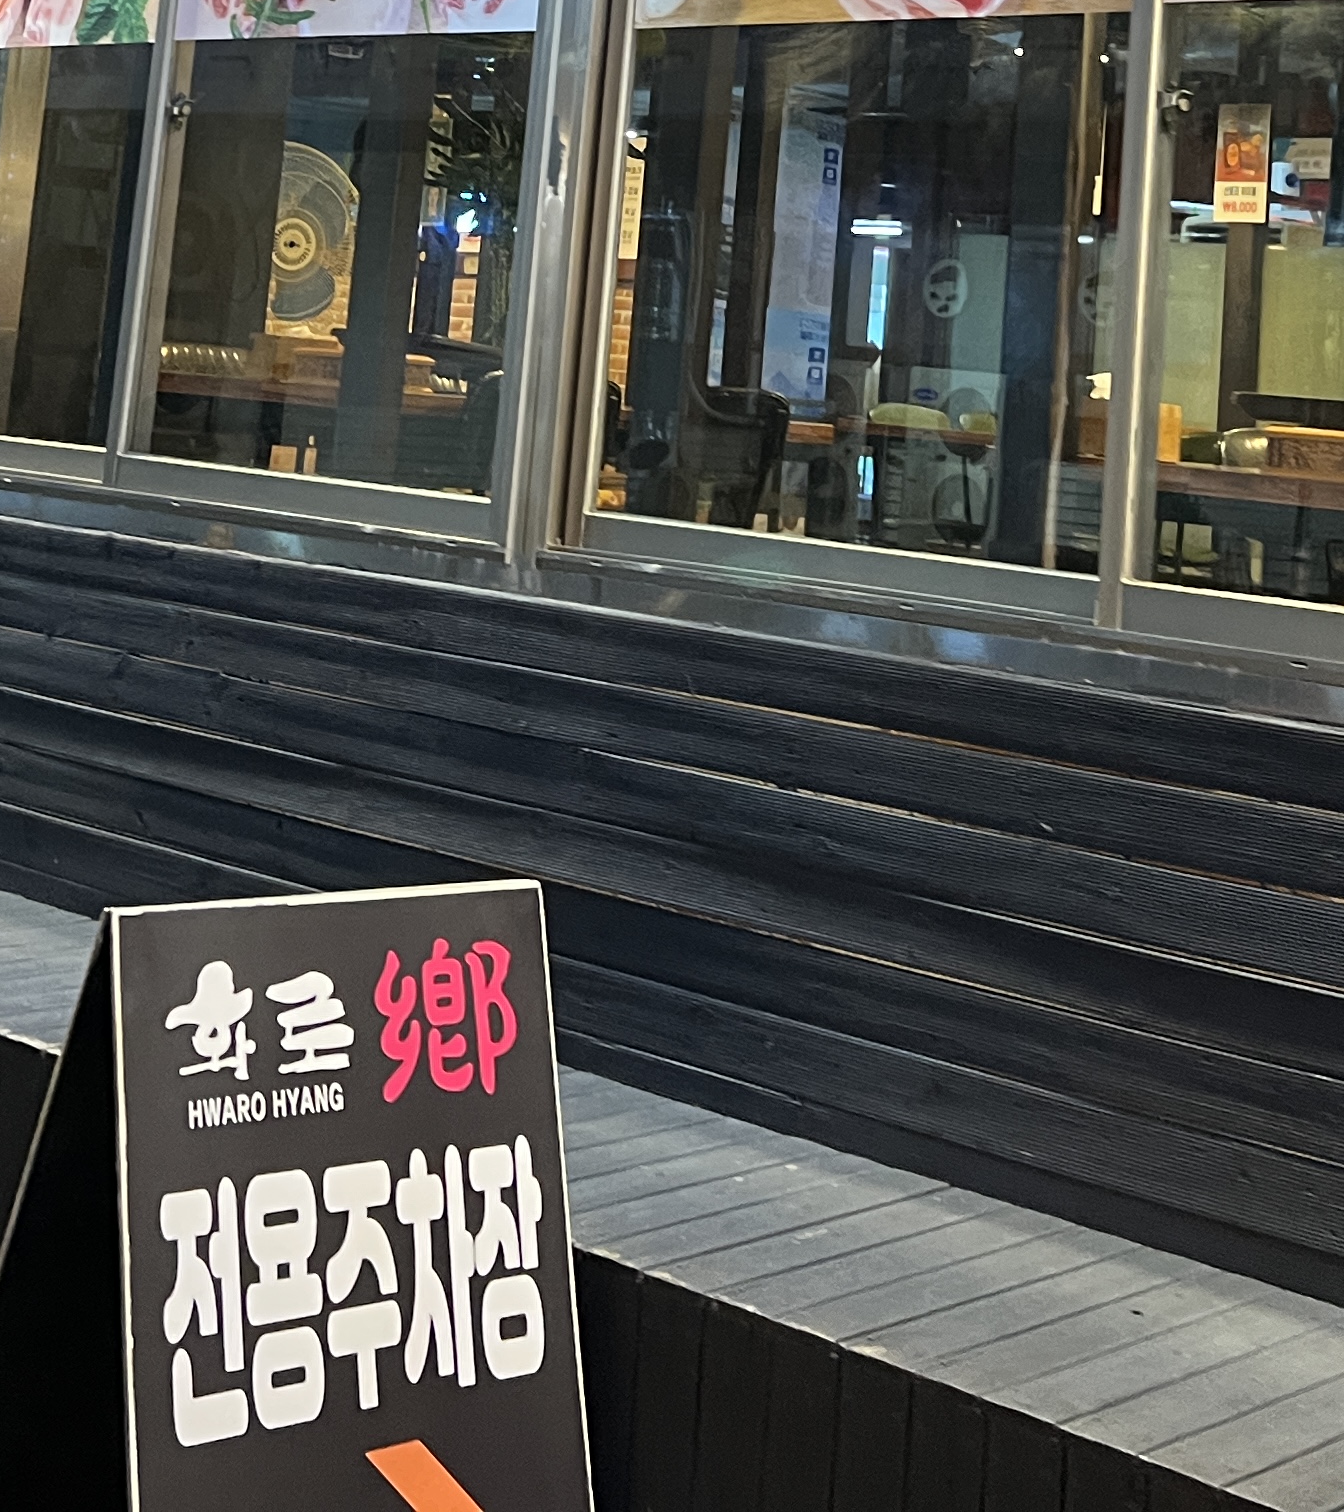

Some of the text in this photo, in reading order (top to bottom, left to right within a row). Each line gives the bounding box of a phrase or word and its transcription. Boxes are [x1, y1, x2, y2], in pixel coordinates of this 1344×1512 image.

[187, 1081, 346, 1130] HWARO HYANG
[159, 1133, 546, 1448] 전용주차장
